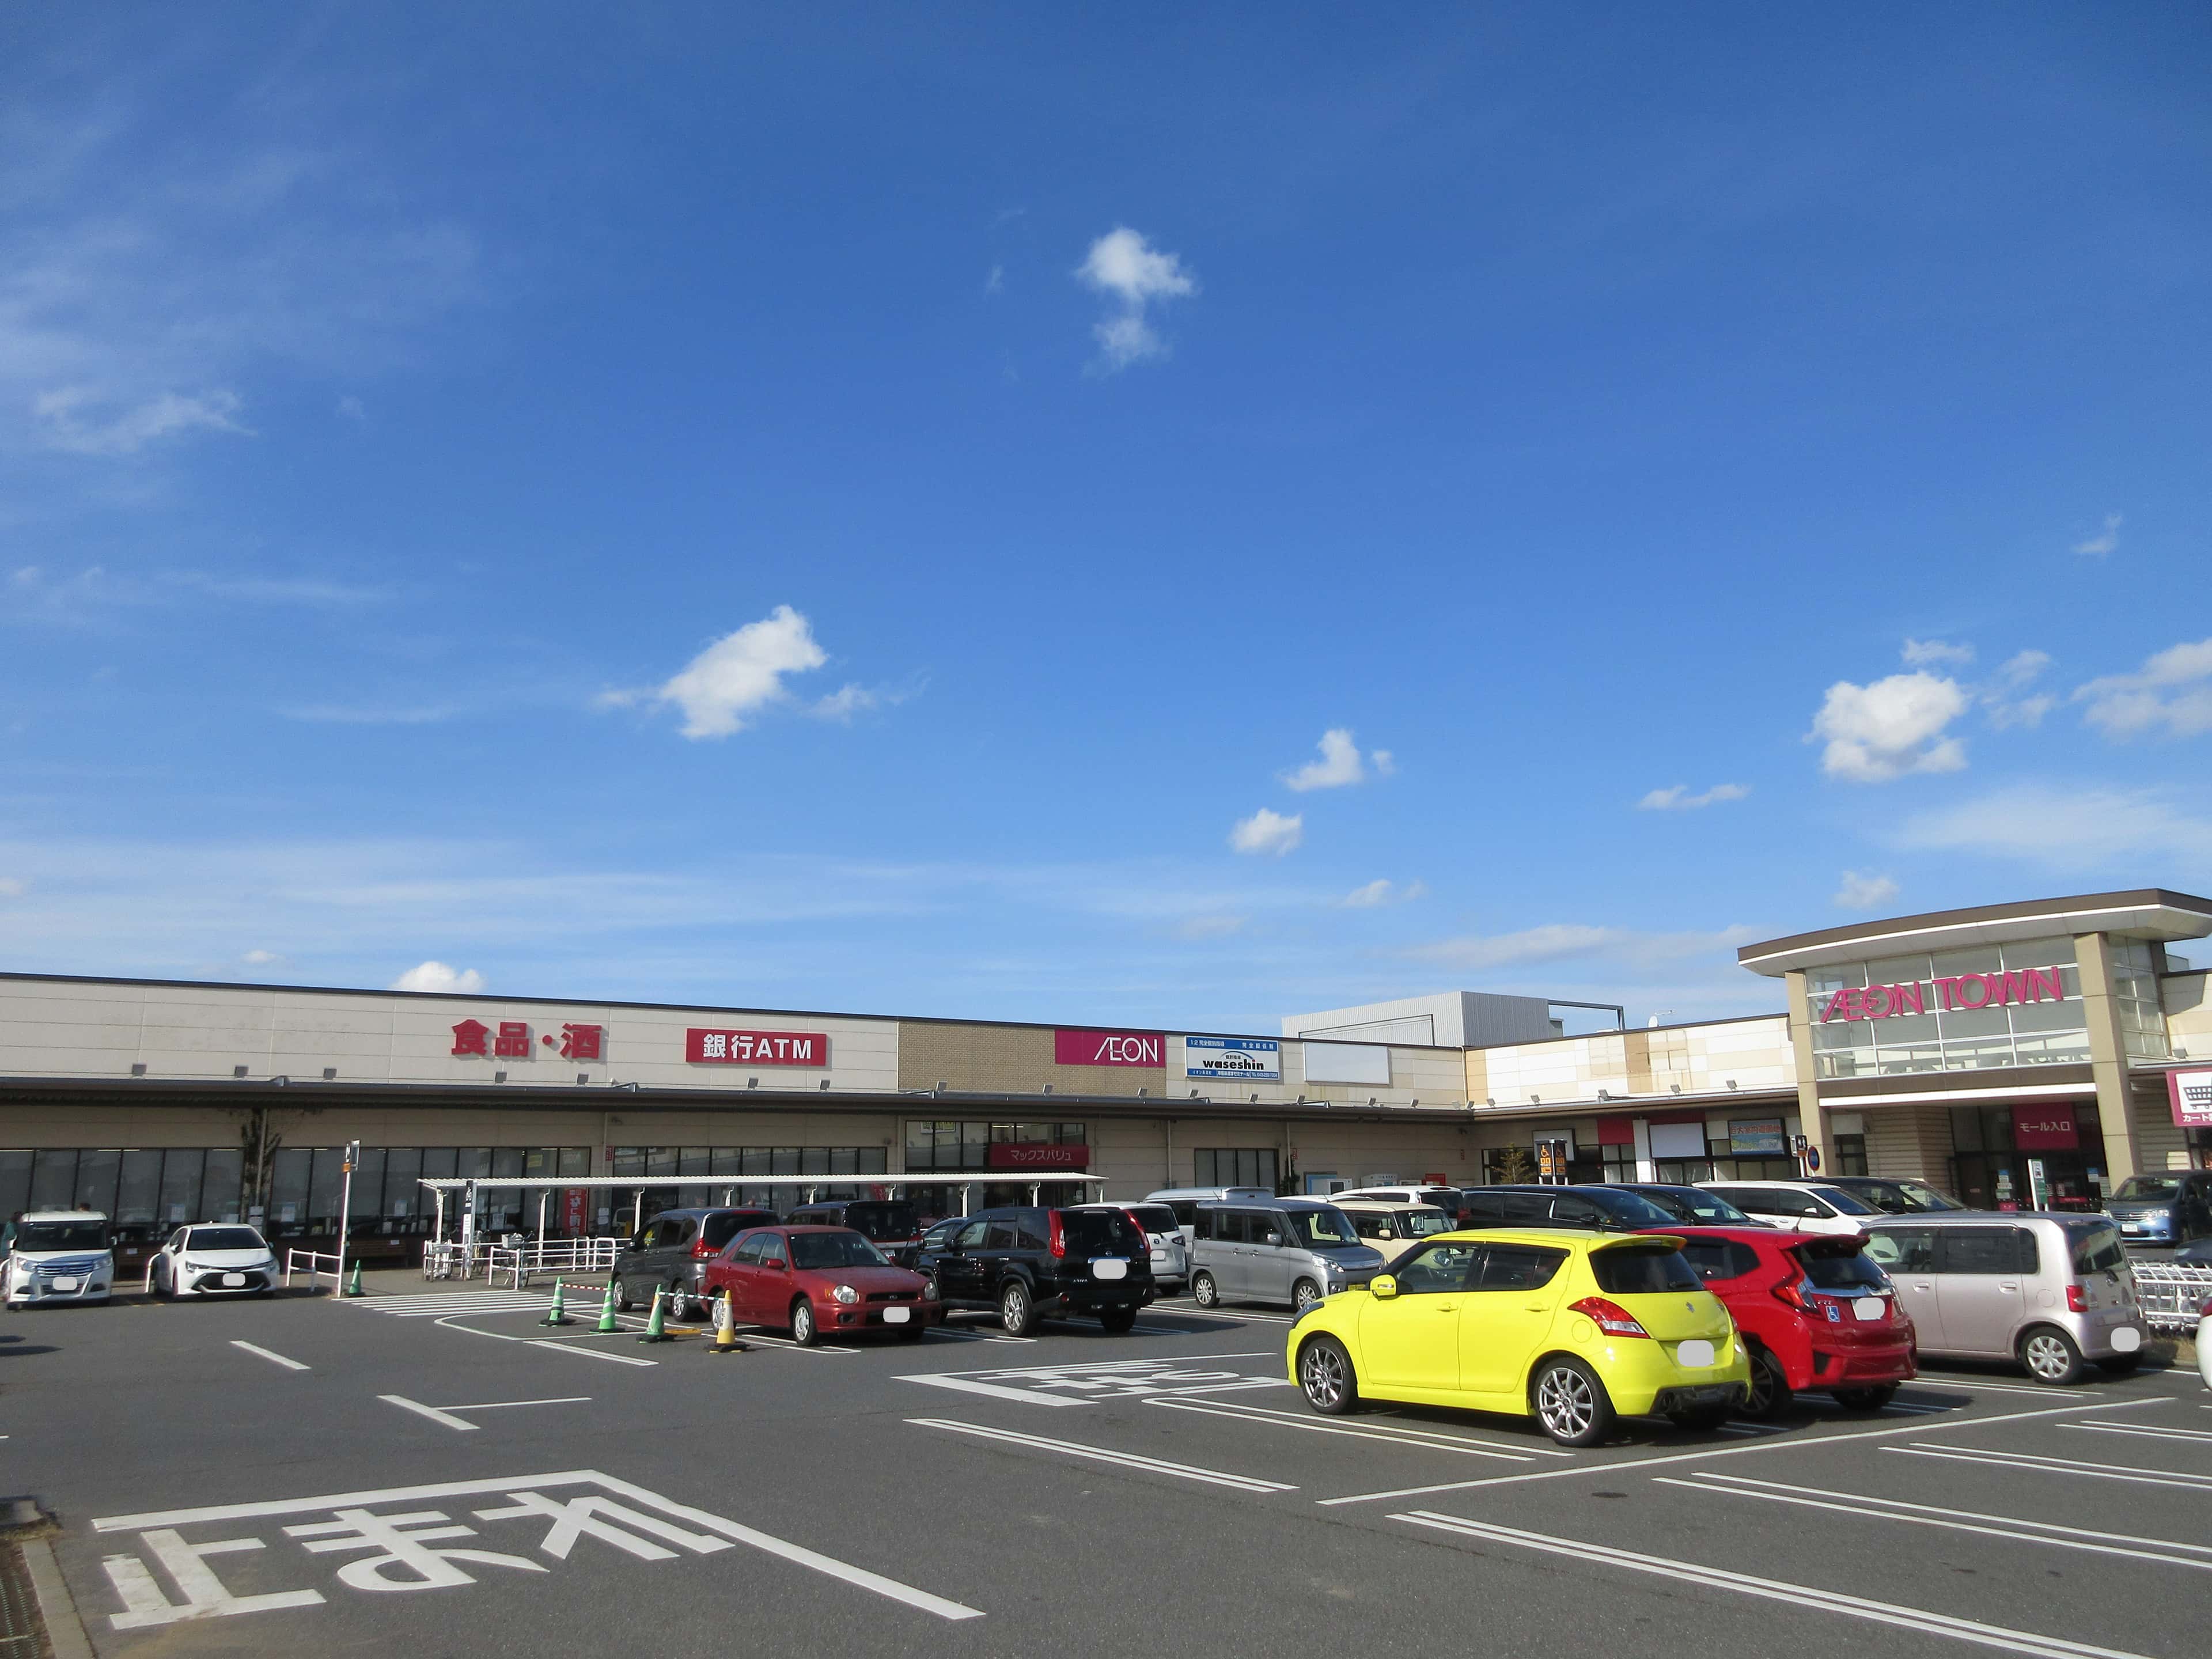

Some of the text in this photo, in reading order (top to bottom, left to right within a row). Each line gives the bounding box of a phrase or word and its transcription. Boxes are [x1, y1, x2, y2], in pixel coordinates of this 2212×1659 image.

[1932, 966, 2063, 1011] TOWN
[451, 1018, 602, 1059] 食品・酒
[703, 1033, 812, 1059] 銀行ATM
[1203, 1059, 1264, 1070] waseshin
[2019, 1121, 2070, 1132] モール入口
[1010, 1149, 1072, 1161] マックスバリュ
[103, 1489, 736, 1631] 止まれ
